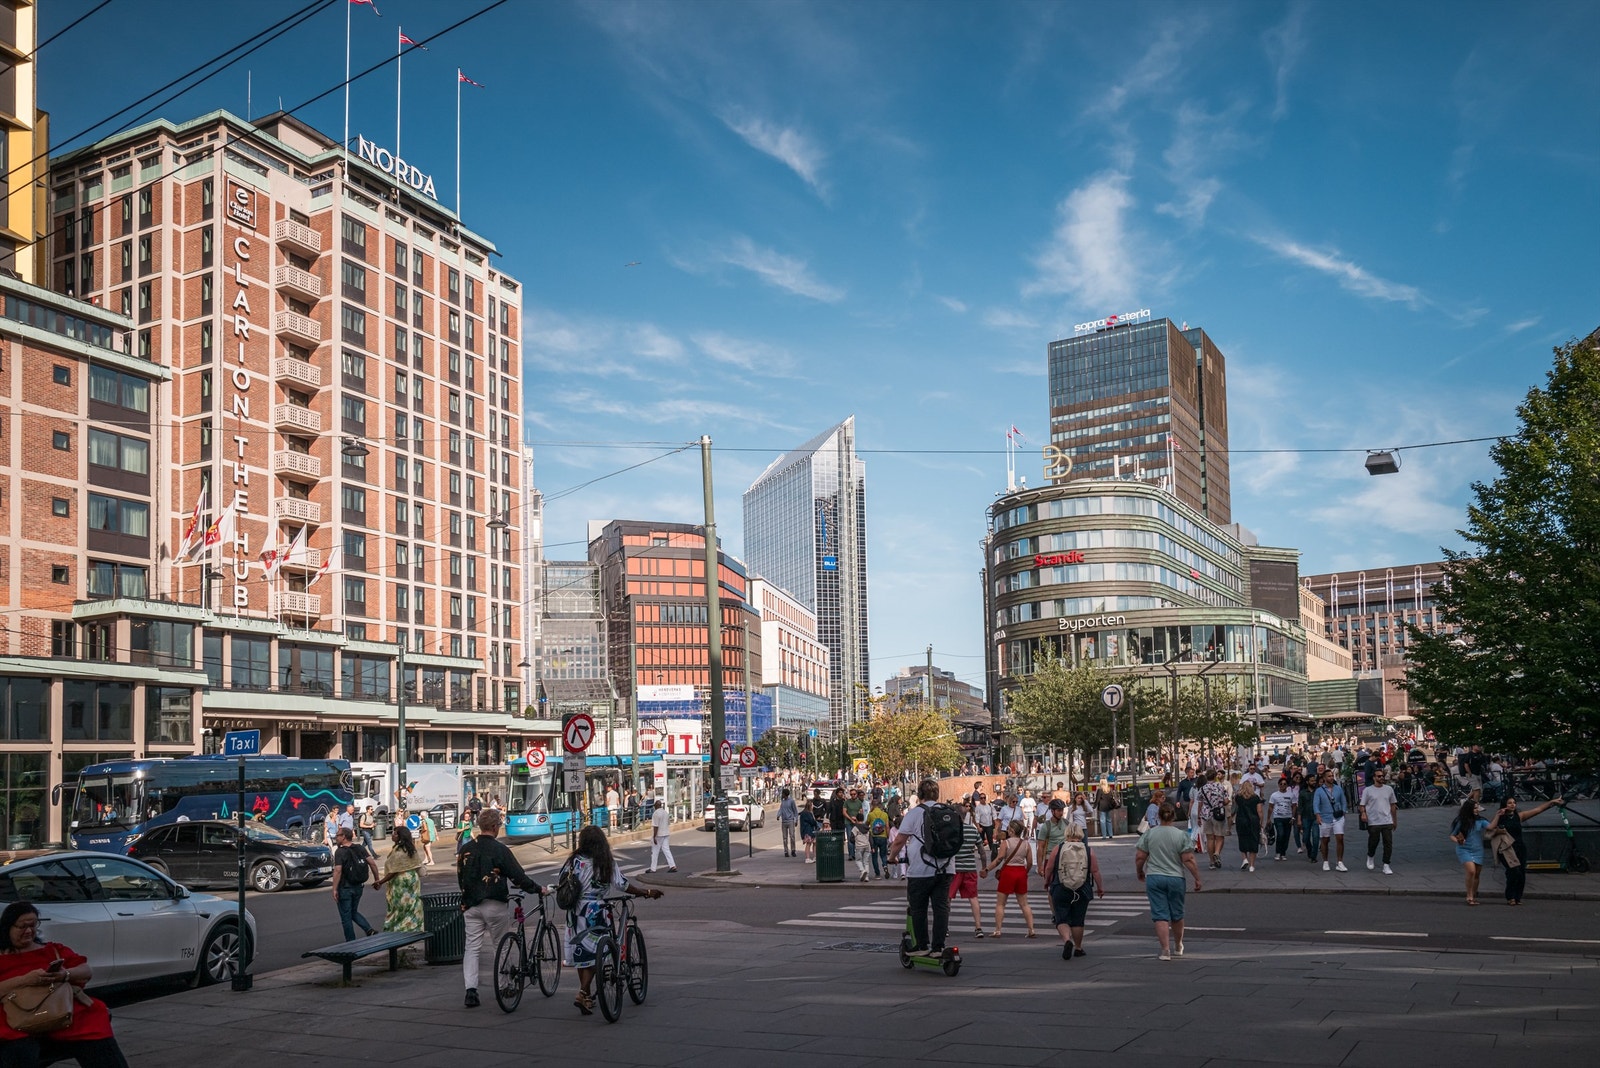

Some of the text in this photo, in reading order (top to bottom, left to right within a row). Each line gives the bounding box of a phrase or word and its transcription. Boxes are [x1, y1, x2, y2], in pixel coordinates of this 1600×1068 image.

[358, 133, 438, 201] NORDA
[230, 200, 254, 218] Clarion
[233, 208, 250, 222] Hotel
[1074, 308, 1151, 332] sopra steria
[232, 236, 251, 608] CLARION THE HUB
[1034, 550, 1085, 567] Scandic
[1059, 614, 1126, 631] Byporten
[1106, 691, 1117, 705] T
[205, 719, 254, 728] LARION
[230, 735, 255, 751] Taxi
[181, 947, 195, 959] TF84
